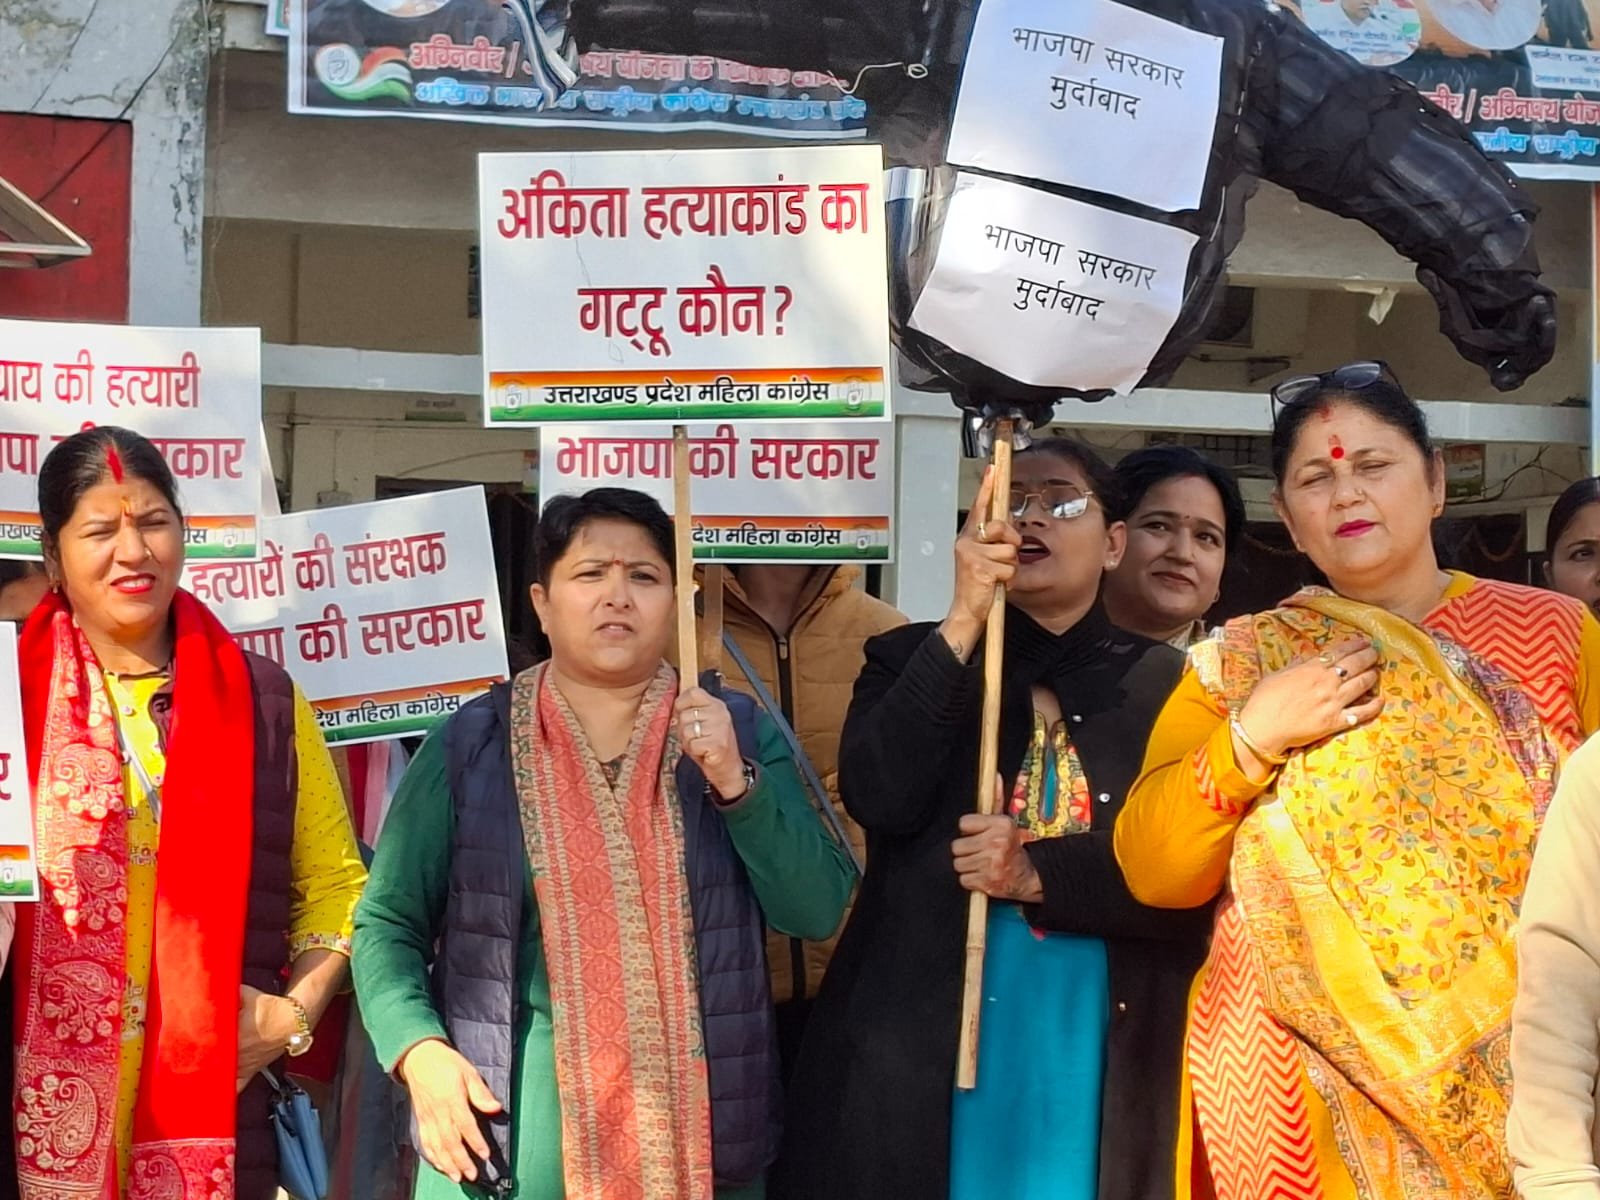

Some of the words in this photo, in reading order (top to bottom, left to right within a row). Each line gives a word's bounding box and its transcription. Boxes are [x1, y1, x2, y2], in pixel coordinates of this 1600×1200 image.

[1011, 26, 1096, 64] भाजपा
[1103, 46, 1186, 90] सरकार
[1049, 75, 1142, 120] मुर्दाबाद
[496, 168, 630, 240] अंकिता
[641, 173, 810, 240] हत्याकांड
[818, 182, 870, 234] का
[983, 222, 1065, 266] भाजपा
[1077, 248, 1157, 291] सरकार
[577, 285, 672, 357] गट्टू
[1012, 277, 1105, 321] मुर्दाबाद
[53, 348, 95, 405] की
[105, 351, 201, 409] हत्यारी
[543, 383, 638, 405] उत्तराखण्ड
[644, 378, 693, 404] प्रदेश
[698, 377, 761, 405] महिला
[766, 377, 831, 405] कांग्रेस
[556, 437, 674, 479] भाजपा
[687, 423, 739, 479] की
[750, 437, 880, 480] सरकार
[691, 524, 720, 544] देश
[725, 522, 780, 545] महिला
[785, 523, 842, 547] कांग्रेस
[187, 540, 285, 604] हत्यारों
[292, 533, 336, 592] की
[342, 532, 447, 586] संरक्षक
[295, 603, 348, 663] की
[358, 598, 487, 656] सरकार
[345, 699, 401, 724] महिला
[404, 692, 462, 716] कांग्रेस
